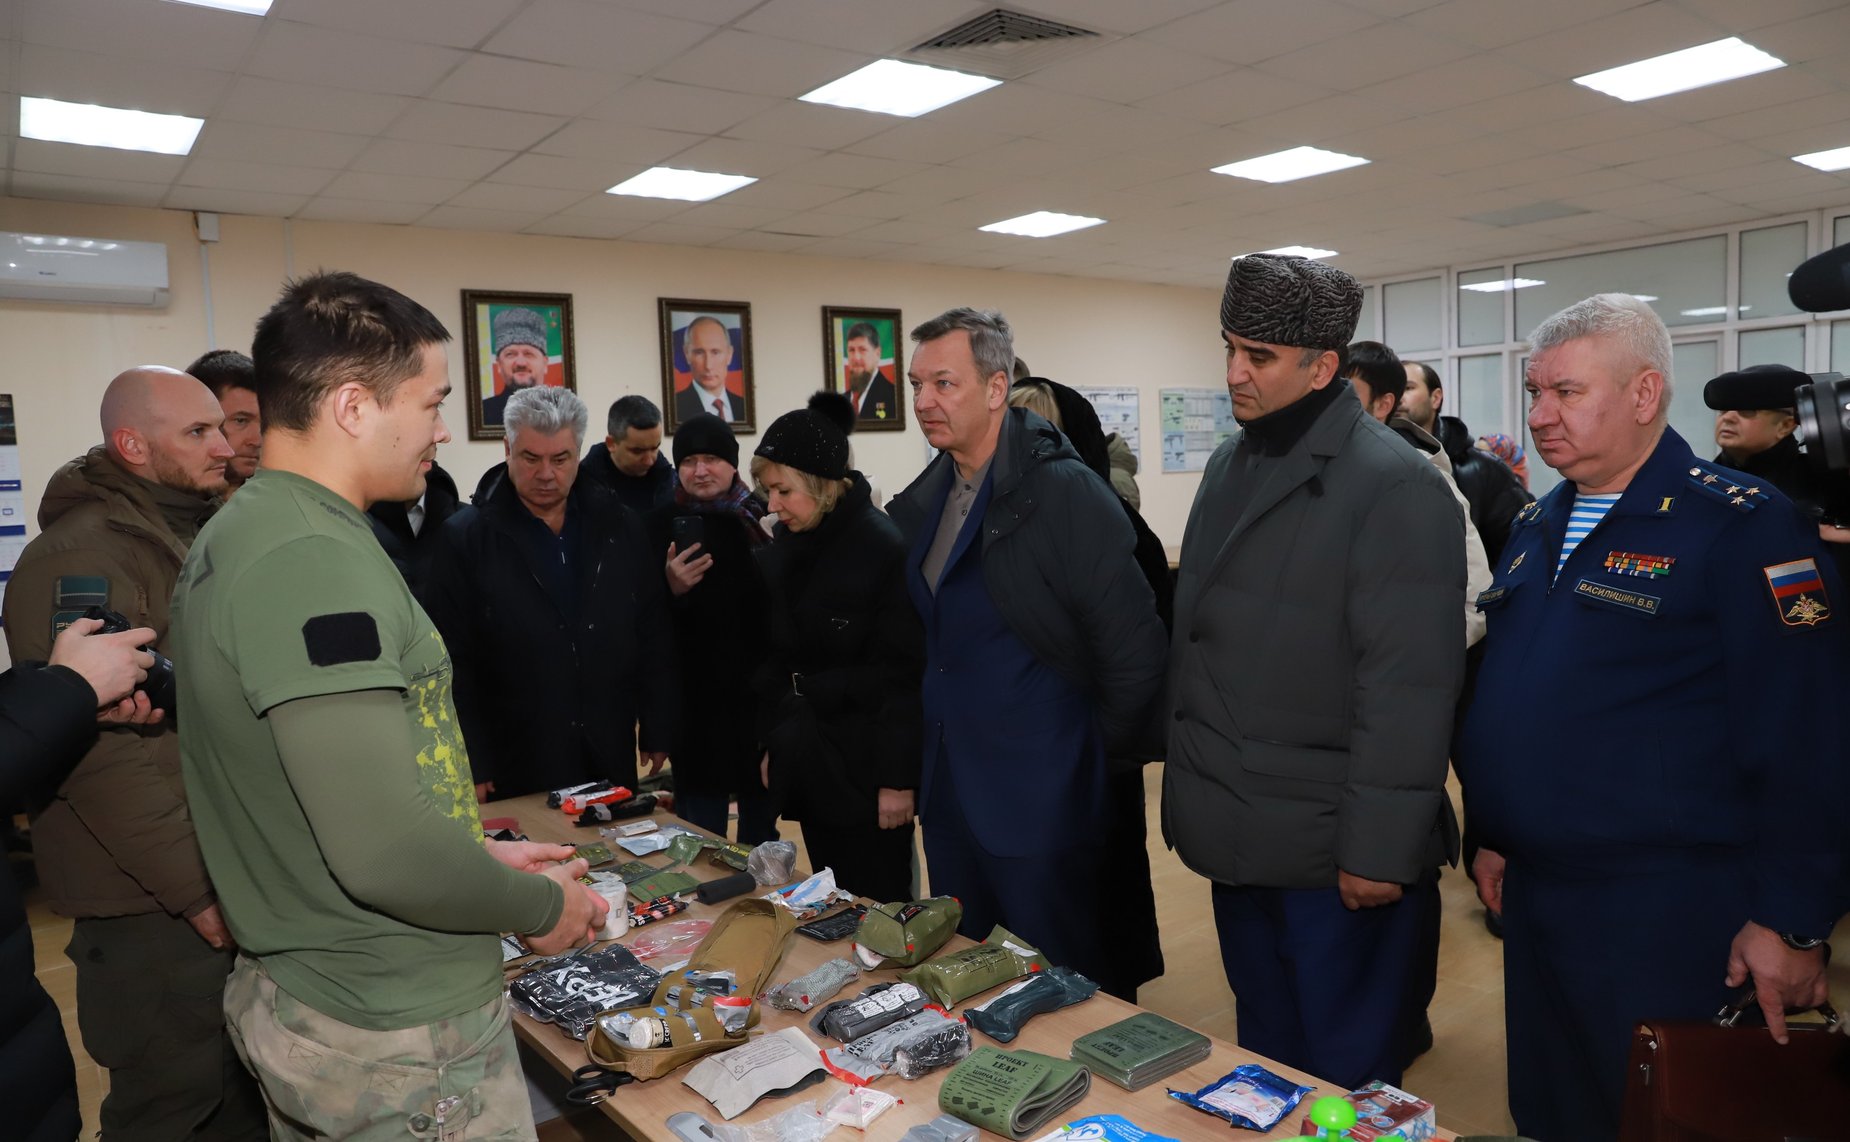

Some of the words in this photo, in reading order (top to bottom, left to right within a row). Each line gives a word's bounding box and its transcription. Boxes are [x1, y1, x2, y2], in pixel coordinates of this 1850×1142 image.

[1579, 583, 1636, 604] ВАСИЛИШИН
[1637, 598, 1655, 610] В.В.
[992, 1061, 1019, 1074] LEAF
[995, 1054, 1029, 1067] ПРОЕКТ
[972, 1069, 993, 1081] ШИНА
[993, 1075, 1012, 1086] LEAF
